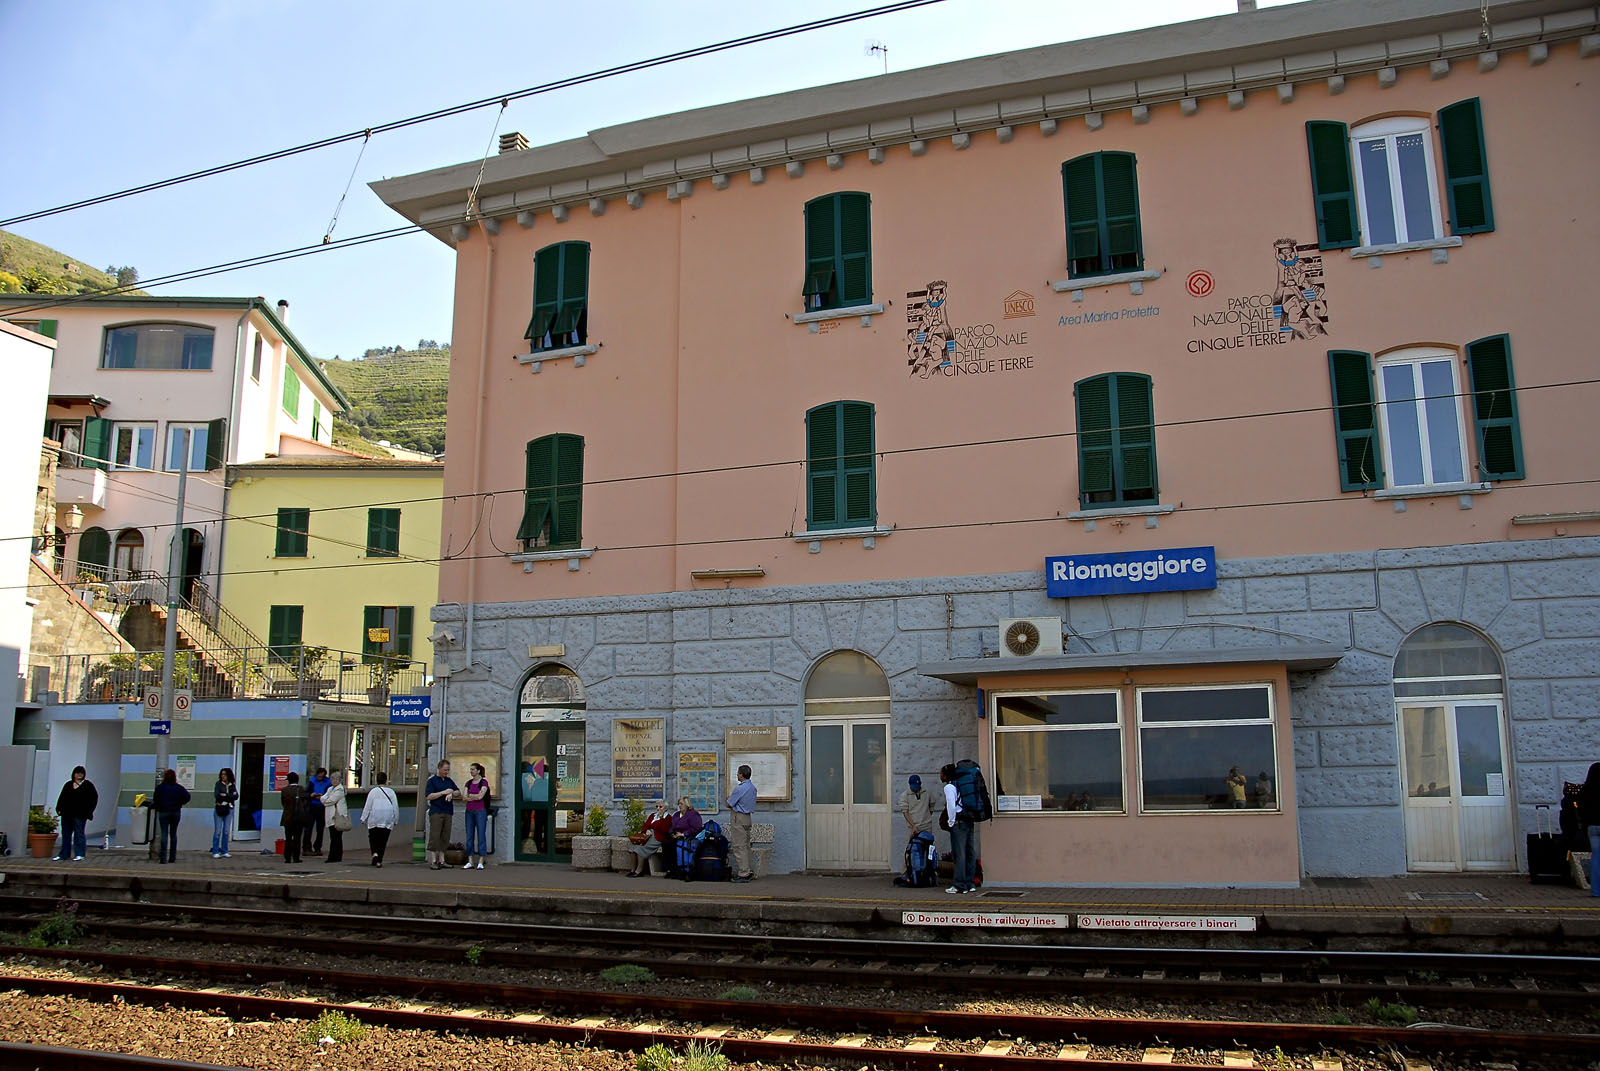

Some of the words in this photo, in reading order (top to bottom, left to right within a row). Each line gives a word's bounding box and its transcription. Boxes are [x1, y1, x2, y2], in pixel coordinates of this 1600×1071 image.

[1004, 299, 1034, 314] UNESCO
[1227, 294, 1273, 310] PARCO
[1058, 315, 1082, 327] Area
[1083, 310, 1119, 324] Marina
[1121, 305, 1160, 320] Protetta
[1193, 307, 1273, 327] NAZIONALE
[954, 323, 995, 339] PARCO
[1240, 320, 1274, 335] DELLE
[955, 332, 1028, 350] NAZIONALE
[1187, 336, 1244, 353] CINQUE
[1247, 332, 1287, 347] TERRE
[955, 348, 986, 363] DELLE
[943, 360, 995, 377] CINQUE
[998, 356, 1034, 371] TERRE
[1052, 554, 1207, 582] Riomaggiore
[400, 708, 420, 718] Spezia
[918, 914, 931, 923] Do
[933, 915, 949, 923] not
[951, 916, 975, 924] cross
[977, 915, 992, 924] the
[995, 915, 1030, 926] railway
[1033, 916, 1056, 925] lines
[1095, 917, 1131, 927] Vietato
[1133, 919, 1197, 928] attraversare
[1199, 919, 1203, 927] i
[1206, 919, 1237, 928] binari
